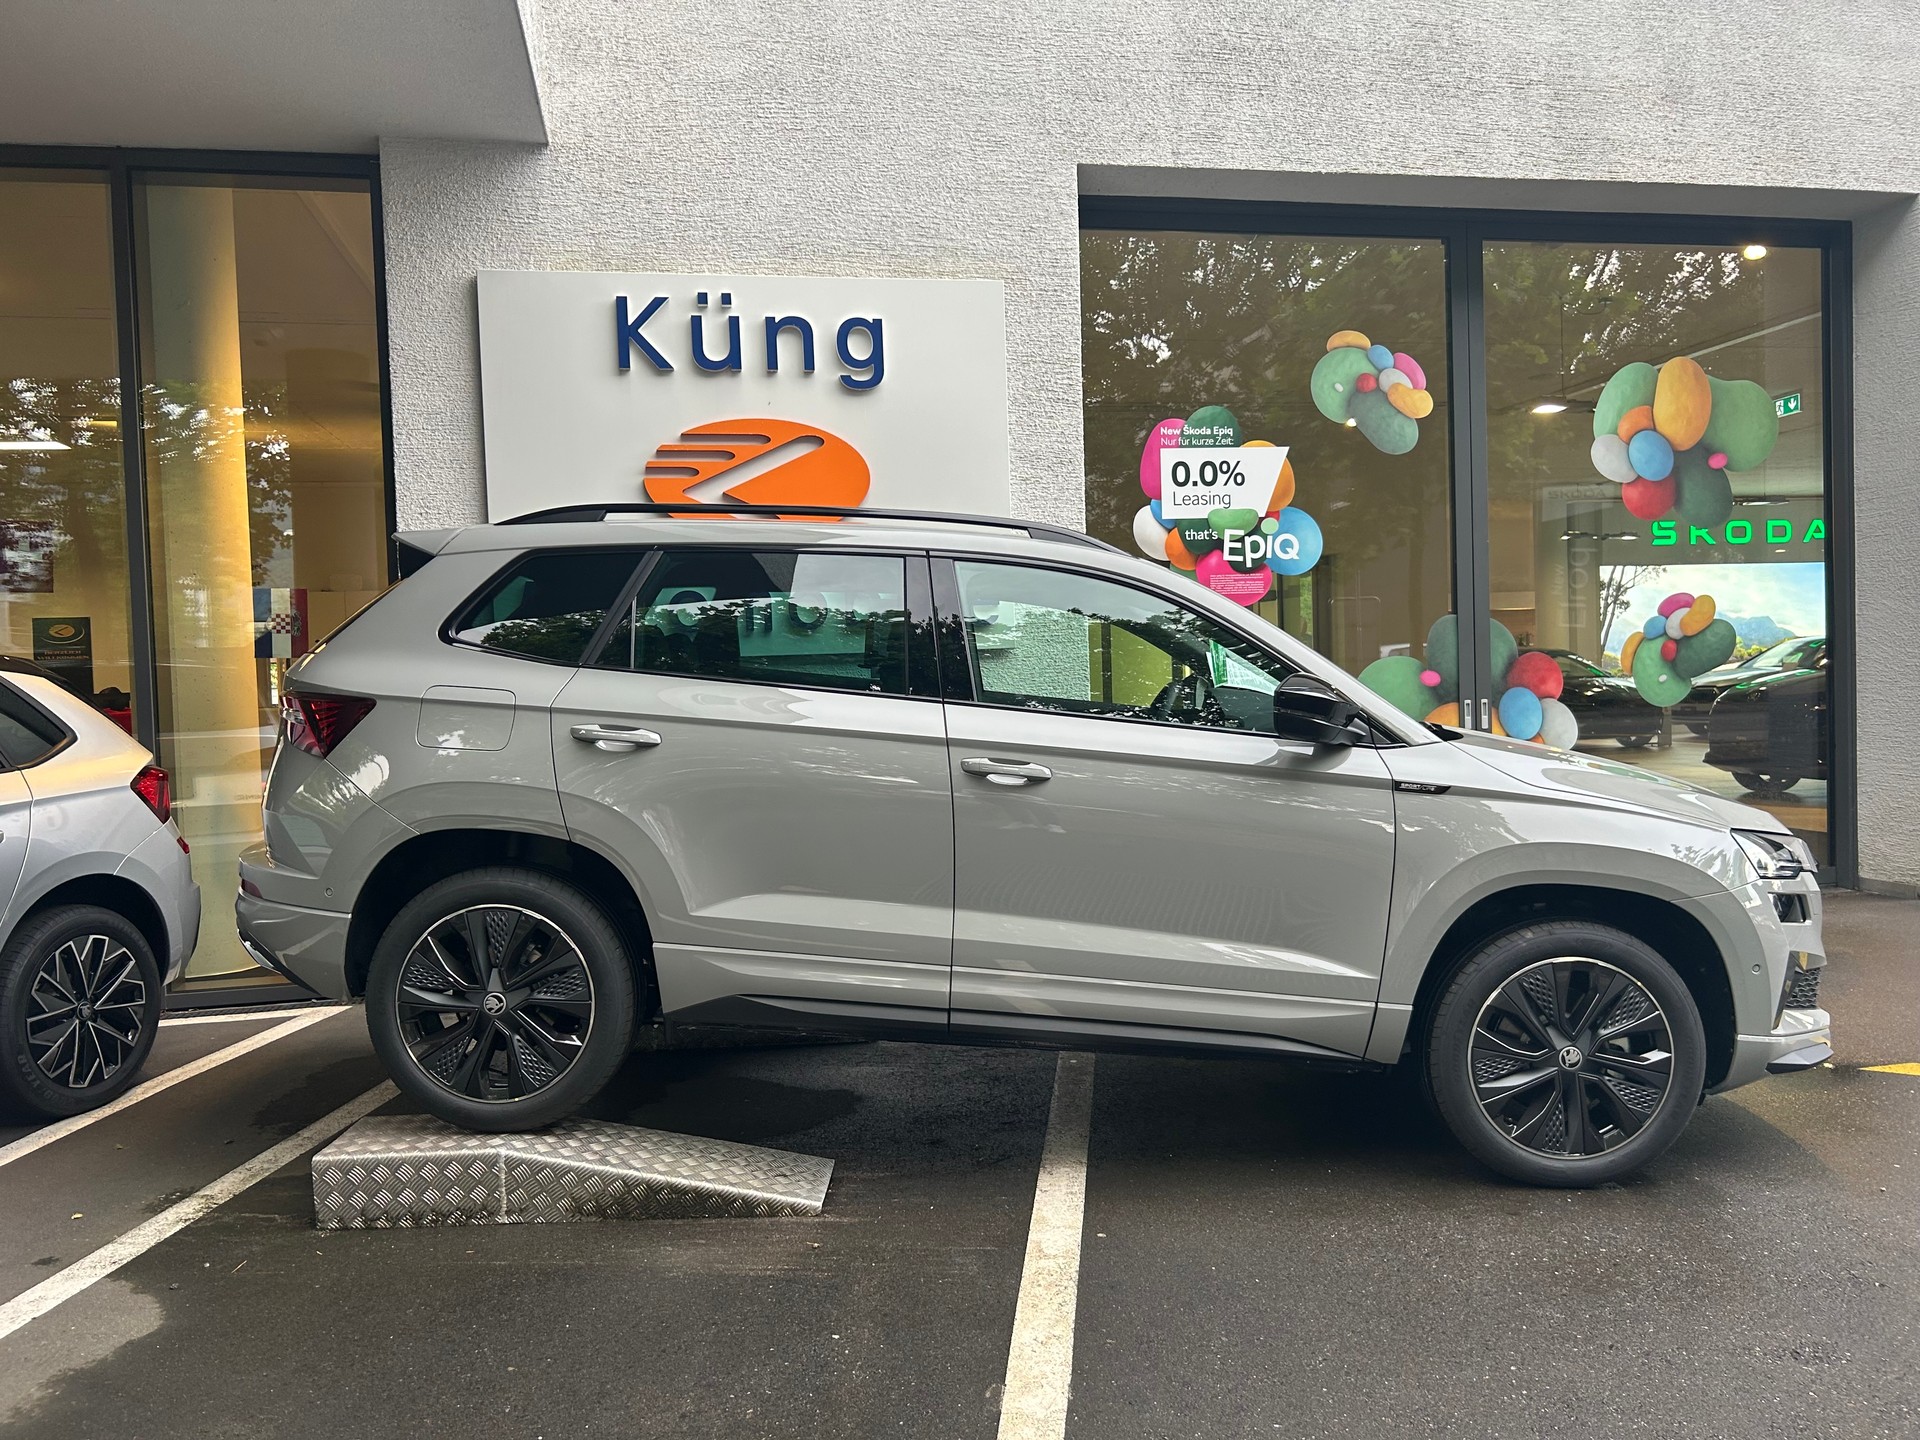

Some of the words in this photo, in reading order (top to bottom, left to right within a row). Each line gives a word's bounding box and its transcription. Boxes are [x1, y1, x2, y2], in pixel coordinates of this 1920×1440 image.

[615, 292, 885, 391] Küng
[1160, 427, 1180, 435] New
[1183, 425, 1211, 435] Škoda
[1213, 426, 1233, 436] Epiq
[1160, 438, 1176, 446] Nur
[1178, 437, 1190, 446] für
[1192, 437, 1214, 446] kurze
[1215, 437, 1234, 446] Zeit:
[1171, 460, 1246, 488] 0.0%
[1173, 491, 1231, 509] Leasing
[1185, 529, 1218, 540] that's
